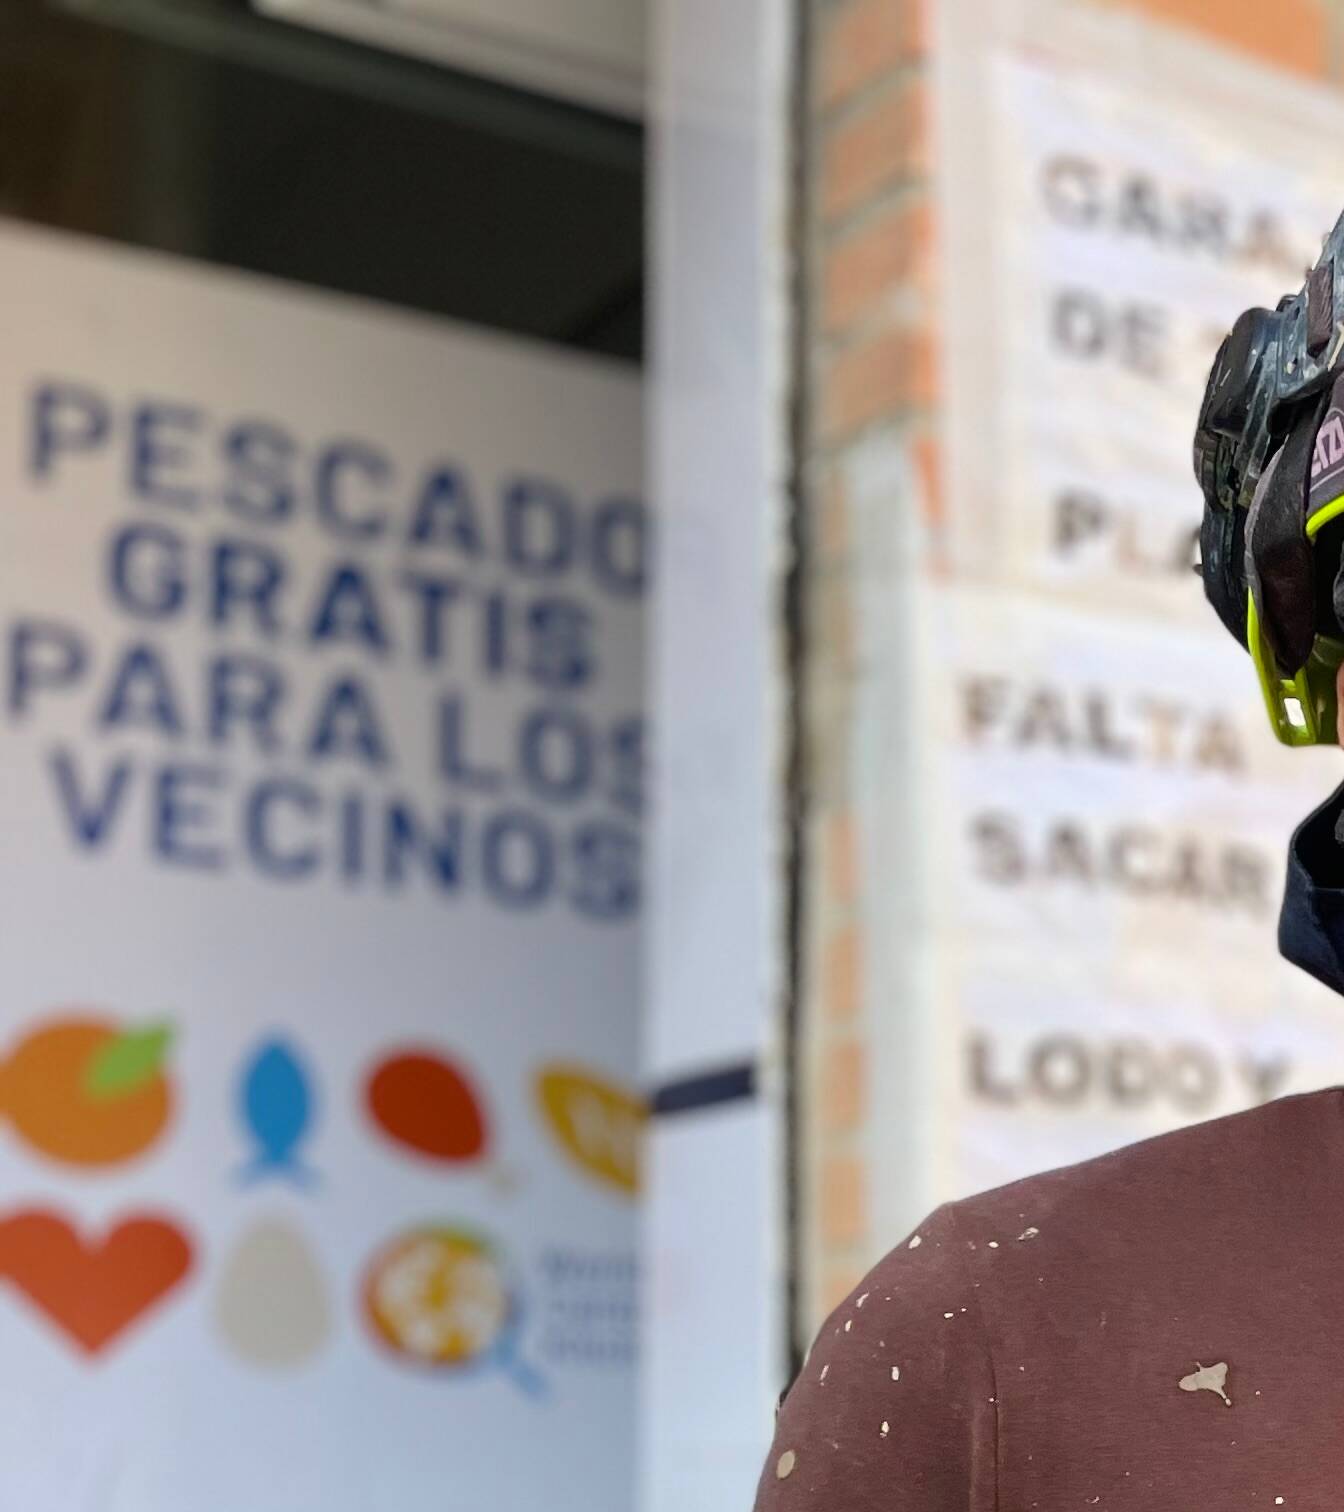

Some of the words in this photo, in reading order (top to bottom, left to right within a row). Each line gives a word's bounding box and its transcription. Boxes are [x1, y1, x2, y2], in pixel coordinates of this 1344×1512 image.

[1051, 294, 1170, 374] DE
[26, 378, 647, 592] PESCADO
[109, 522, 594, 689] GRATIS
[7, 622, 388, 768] PARA
[959, 673, 1246, 768] FALTA
[49, 751, 641, 922] VECINOS
[971, 813, 1272, 913] SACAR
[966, 1029, 1219, 1111] LODO
